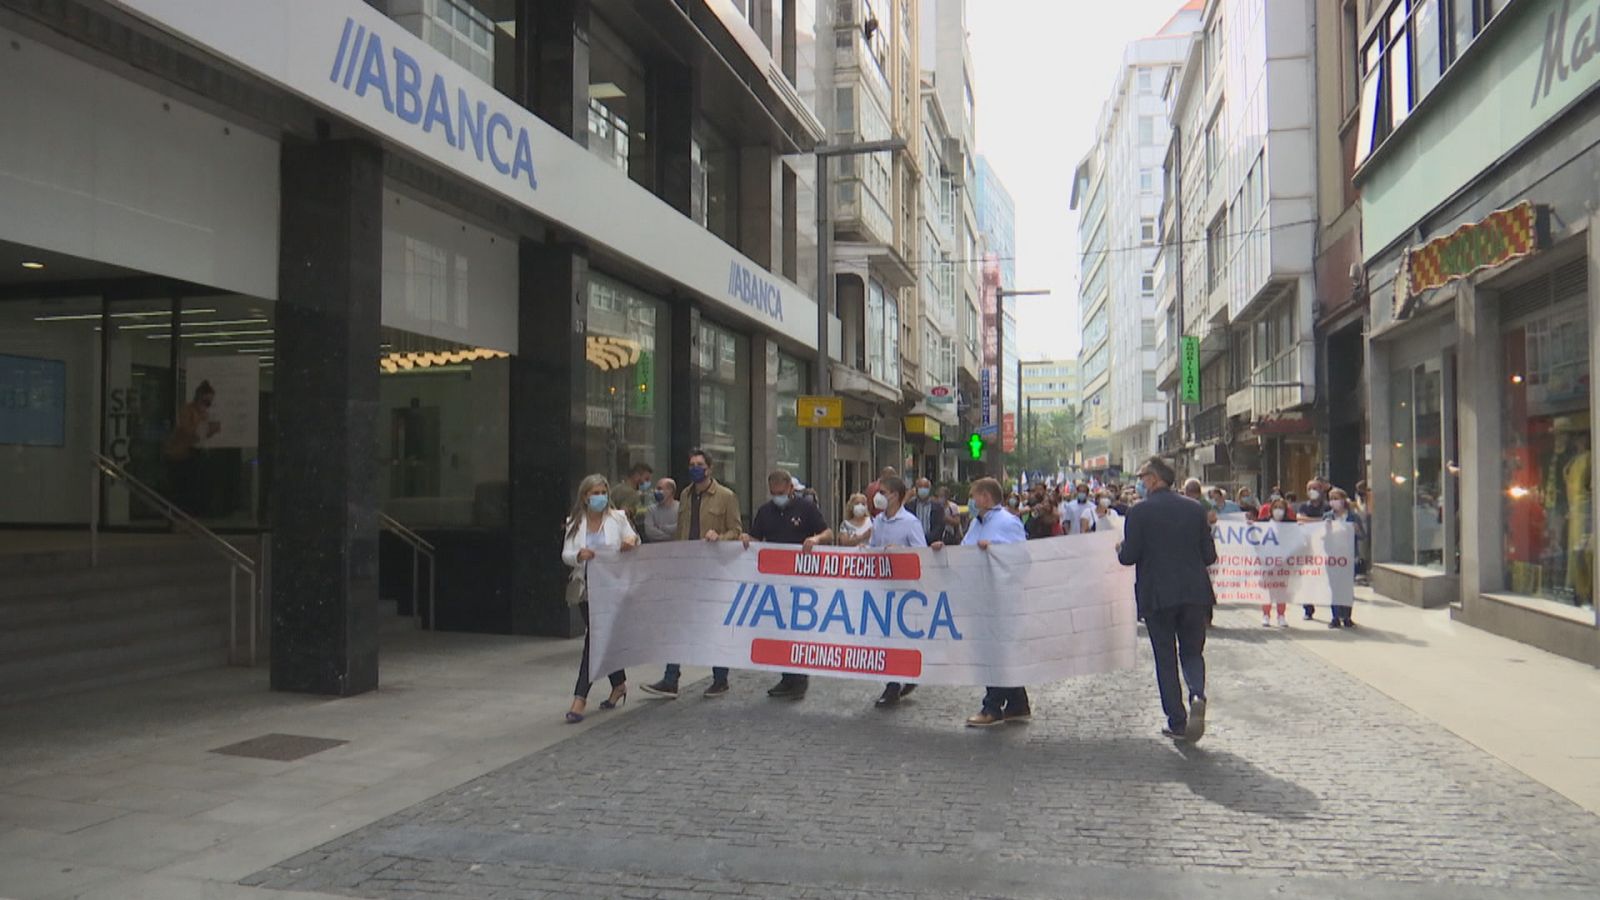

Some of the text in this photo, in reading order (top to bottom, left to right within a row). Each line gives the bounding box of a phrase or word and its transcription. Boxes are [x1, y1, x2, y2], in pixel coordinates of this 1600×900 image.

[794, 554, 893, 577] NON AO PECHE DA
[1265, 556, 1283, 566] DE
[1277, 567, 1290, 576] do
[790, 643, 886, 671] OFICINAS RURAIS
